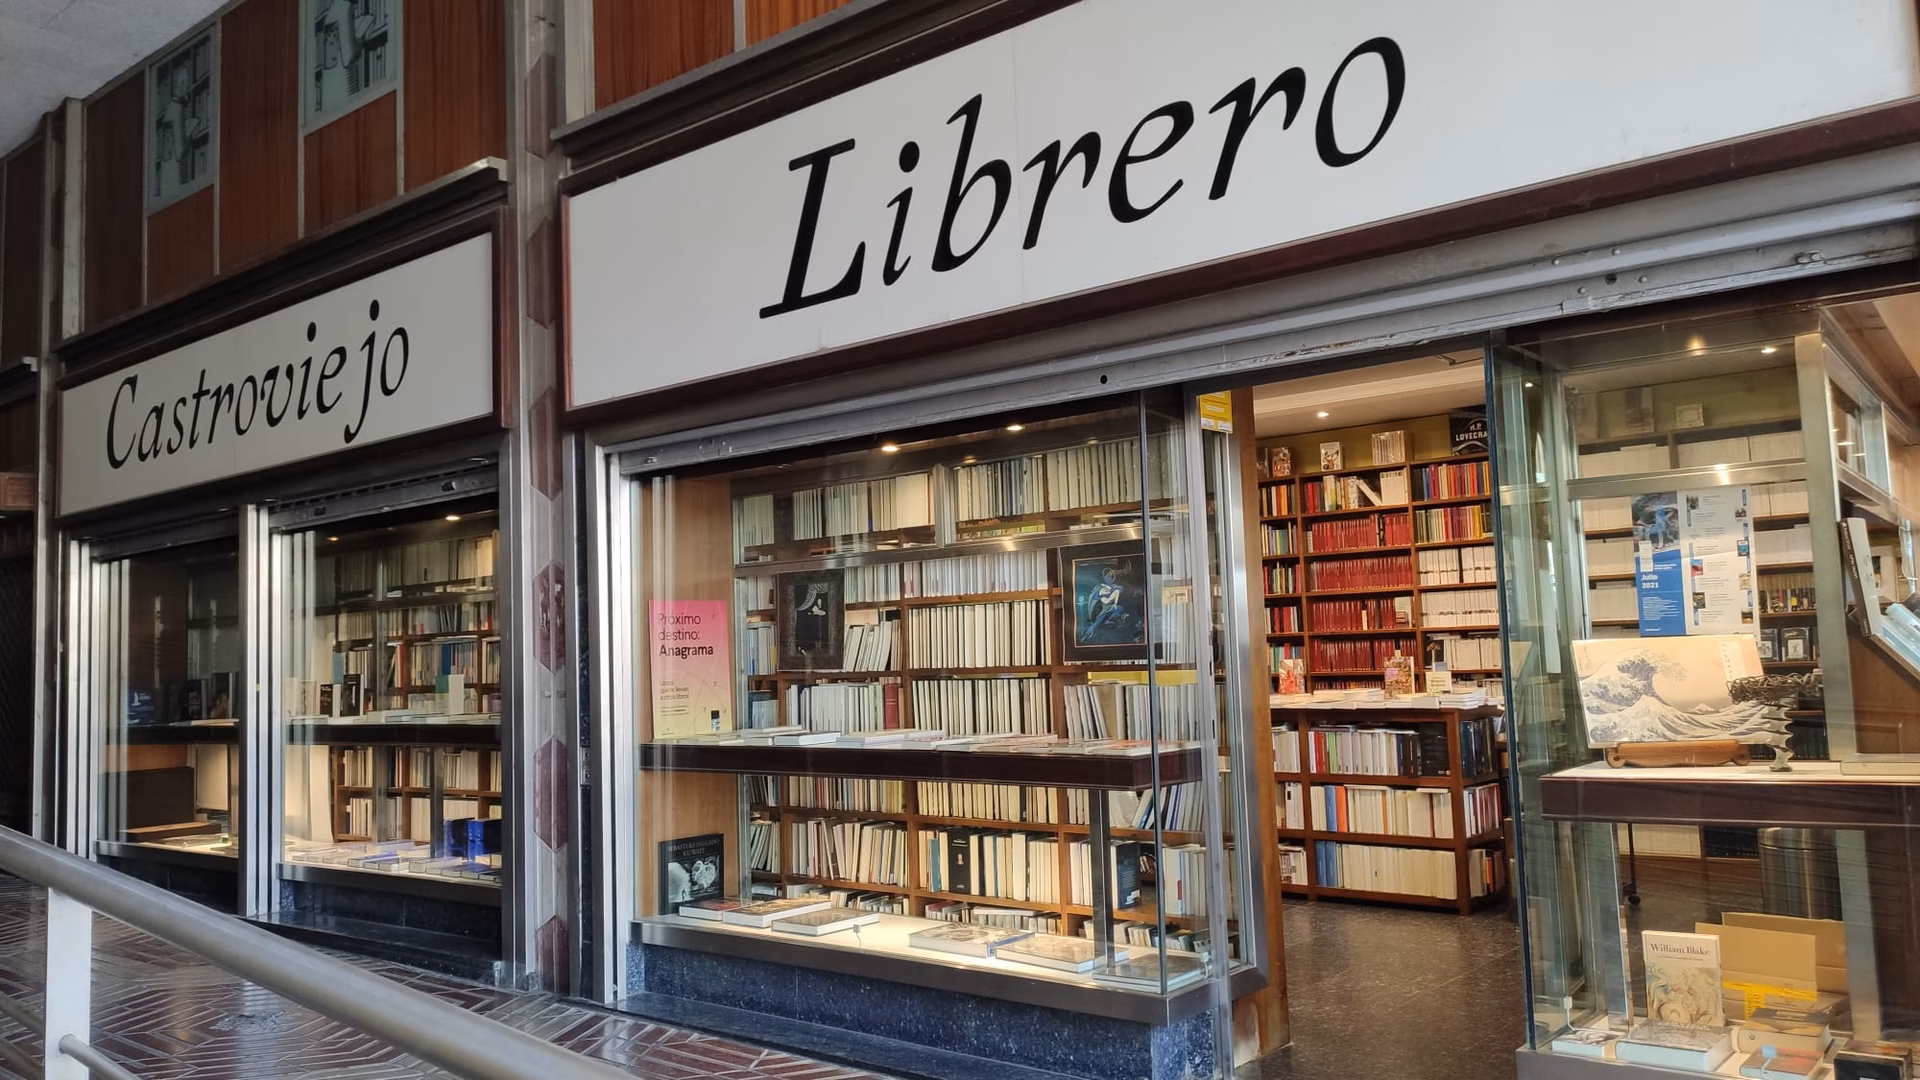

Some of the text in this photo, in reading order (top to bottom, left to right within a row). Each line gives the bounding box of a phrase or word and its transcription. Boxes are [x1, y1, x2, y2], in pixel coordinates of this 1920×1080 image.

[760, 37, 1406, 319] Librero
[107, 300, 410, 470] Castroviejo
[1456, 431, 1488, 441] LOVECRA
[1641, 573, 1658, 581] Julio
[1641, 581, 1659, 589] 2021
[657, 613, 702, 625] Próximo
[658, 628, 701, 641] destino:
[659, 644, 714, 660] Anagrama
[1650, 943, 1709, 955] William Blake
